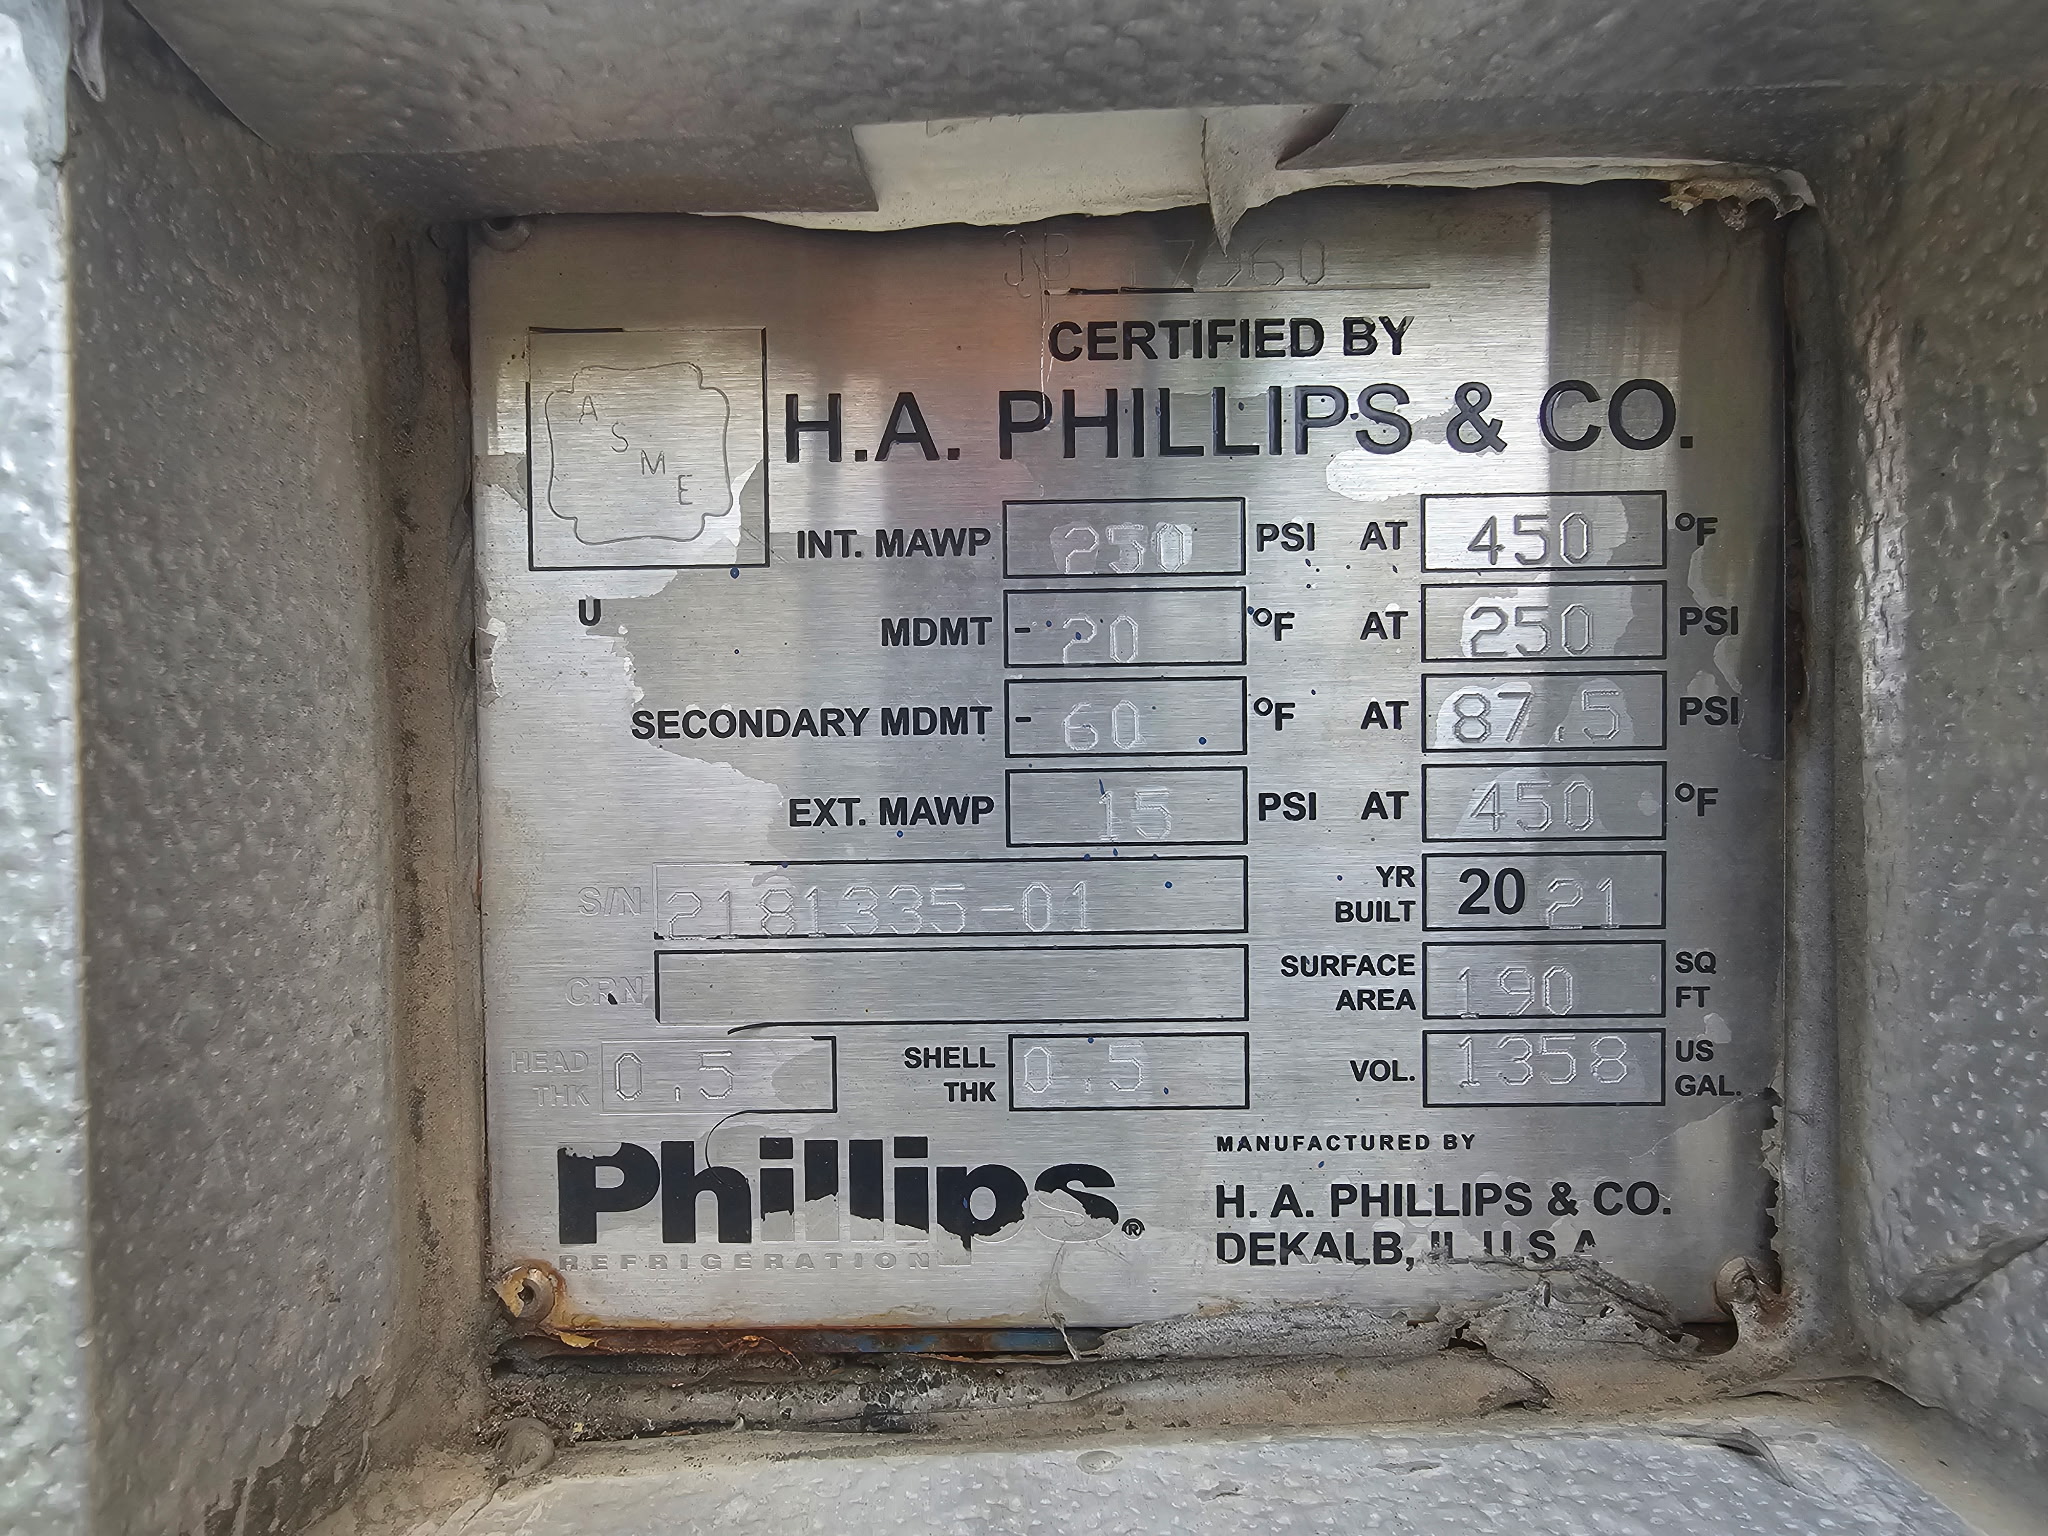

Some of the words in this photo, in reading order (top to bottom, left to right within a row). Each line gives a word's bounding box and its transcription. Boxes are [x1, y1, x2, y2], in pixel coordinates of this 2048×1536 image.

[1048, 318, 1326, 362] CERTIFIED
[1342, 315, 1415, 356] BY
[785, 391, 962, 463] H.A.
[999, 382, 1413, 459] PHILLIPS
[1446, 381, 1508, 454] &
[1540, 378, 1694, 452] CO.
[797, 530, 862, 560] INT.
[876, 527, 991, 558] MAWP
[1063, 523, 1190, 575] 250
[1257, 523, 1315, 552] PSI
[1360, 520, 1408, 551] AT
[1467, 511, 1594, 566] 450
[578, 599, 601, 627] U
[881, 617, 992, 646] MDMT
[1062, 614, 1139, 664] 20
[1360, 611, 1408, 641] AT
[1470, 604, 1595, 656] 250
[1680, 606, 1739, 636] PSI
[632, 708, 871, 739] SECONDARY
[881, 706, 993, 736] MDMT
[1063, 700, 1141, 751] 60
[1361, 700, 1409, 731] AT
[1680, 697, 1739, 726] PSI
[789, 799, 864, 827] EXT.
[880, 796, 995, 825] MAWP
[1099, 789, 1173, 841] 15
[1258, 791, 1317, 821] PSI
[1361, 791, 1409, 820] AT
[1469, 780, 1595, 832] 450
[1376, 866, 1416, 888] YR
[577, 886, 643, 917] S/N
[666, 881, 1092, 940] 2181335-01
[1335, 901, 1416, 923] BUILT
[1458, 868, 1526, 915] 20
[1547, 877, 1620, 930] 21
[1281, 954, 1416, 977] SURFACE
[1675, 952, 1717, 975] SQ
[564, 976, 645, 1006] CRN
[1336, 988, 1416, 1011] AREA
[1456, 965, 1574, 1020] 190
[1676, 987, 1711, 1009] FT
[510, 1050, 590, 1074] HEAD
[904, 1046, 996, 1069] SHELL
[1350, 1060, 1415, 1083] VOL.
[1458, 1034, 1629, 1089] 1358
[1675, 1040, 1714, 1063] US
[532, 1084, 591, 1107] THK
[944, 1081, 996, 1103] THK
[1675, 1074, 1742, 1097] GAL.
[1217, 1134, 1430, 1152] MANUFACTURED
[1443, 1133, 1476, 1151] BY
[557, 1135, 1119, 1266] Phillips
[1216, 1184, 1257, 1218] H.
[1271, 1184, 1313, 1218] A.
[1331, 1182, 1530, 1217] PHILLIPS
[1547, 1181, 1579, 1215] &
[1593, 1180, 1672, 1215] CO.
[560, 1254, 931, 1271] REFRIGERATION
[1216, 1230, 1415, 1271] DEKALB,
